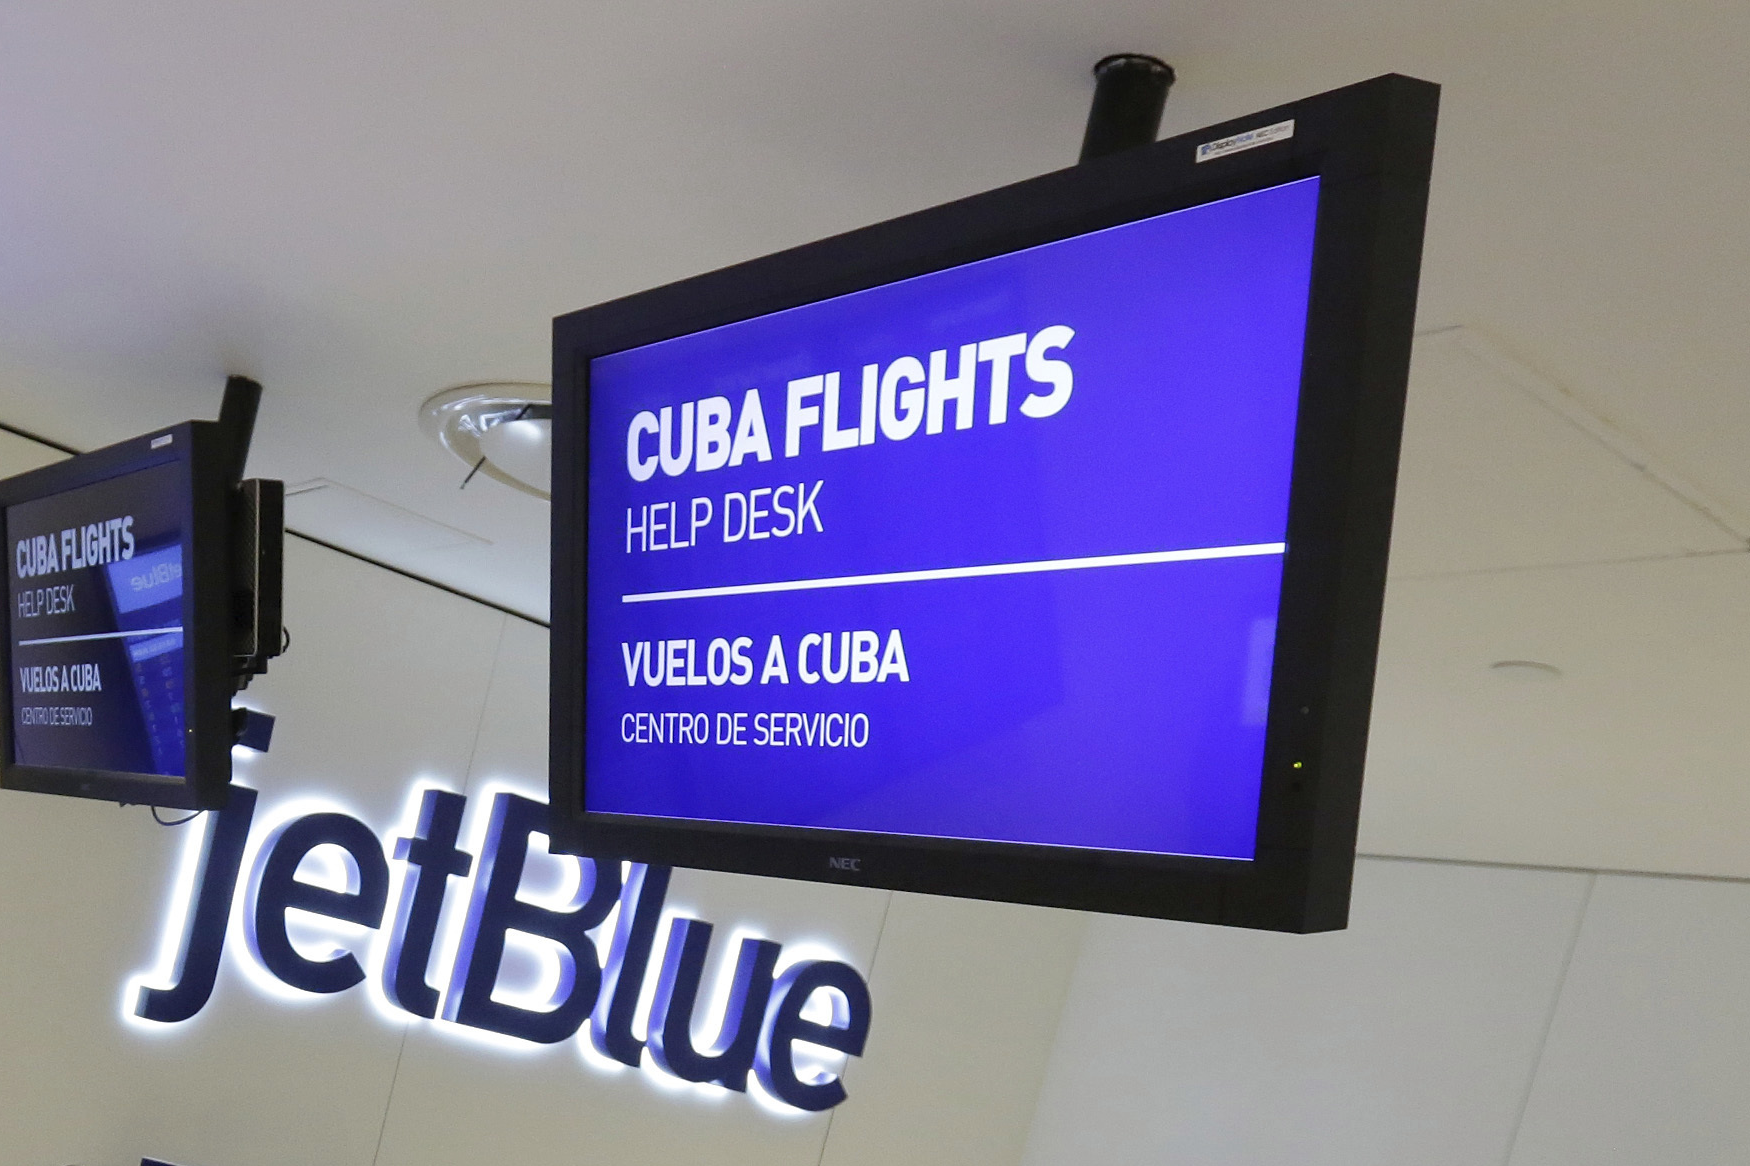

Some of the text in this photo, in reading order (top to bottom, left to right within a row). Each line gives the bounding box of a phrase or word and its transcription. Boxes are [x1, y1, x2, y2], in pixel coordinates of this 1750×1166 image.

[626, 324, 1076, 483] CUBA FLIGHTS
[625, 479, 825, 554] HELP DESK
[16, 515, 135, 579] CUBA FLIGHTS
[18, 584, 76, 618] HELP DESK
[19, 663, 103, 693] VUELOS A CUBA
[621, 628, 911, 687] VUELOS A CUBA
[21, 706, 93, 727] CENTRO DE SERVICIO
[621, 712, 870, 749] CENTRO DE SERVICIO
[829, 857, 861, 872] NEC
[134, 706, 874, 1113] jetBlue
